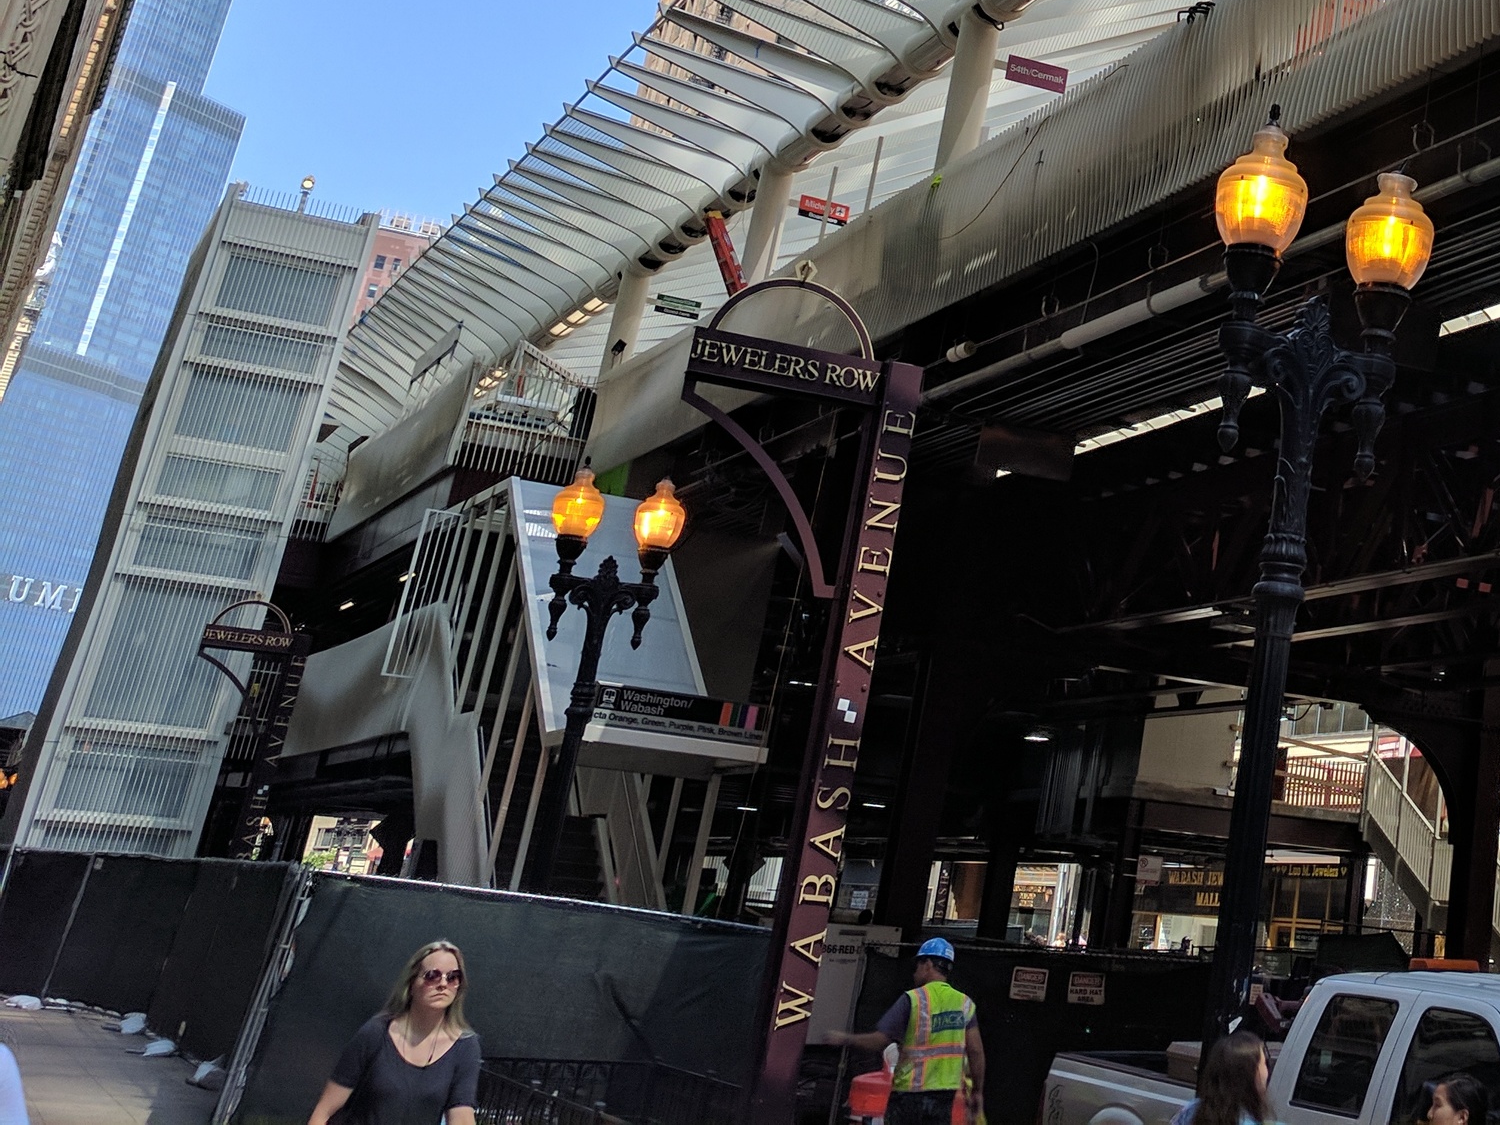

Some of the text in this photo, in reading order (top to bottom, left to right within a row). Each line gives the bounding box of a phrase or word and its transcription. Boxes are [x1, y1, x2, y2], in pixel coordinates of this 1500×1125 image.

[1010, 63, 1064, 85] 54th/Cermak
[691, 337, 881, 394] JEWELERS ROW
[202, 628, 294, 648] JEWELERS ROW
[620, 699, 665, 716] Wabash
[622, 688, 695, 710] Washington/
[263, 654, 307, 768] AVENUE
[773, 409, 916, 1032] WABASH AVENUE
[593, 710, 607, 720] cta
[608, 713, 640, 726] Orange,
[641, 717, 666, 728] Green,
[668, 721, 695, 732] Purple,
[697, 724, 716, 735] Pink,
[718, 727, 743, 737] Brown
[1168, 870, 1204, 886] WABASH
[1196, 892, 1221, 907] MALL
[1069, 988, 1088, 996] HARD
[1077, 995, 1095, 1003] AREA
